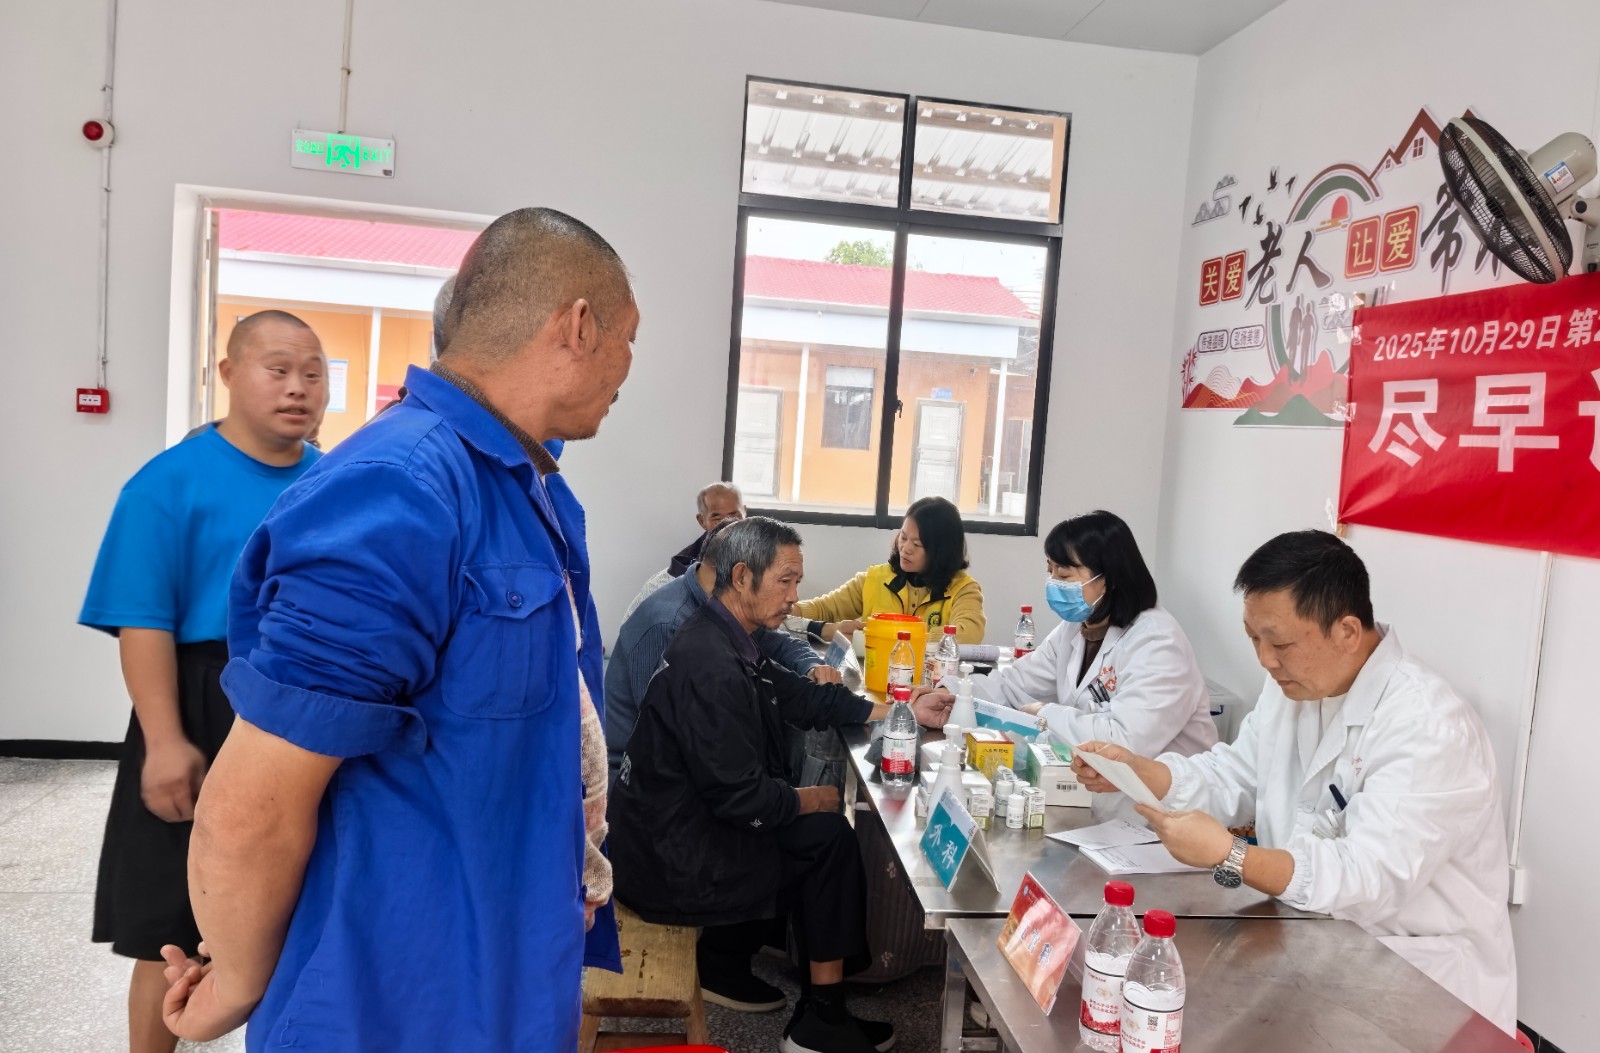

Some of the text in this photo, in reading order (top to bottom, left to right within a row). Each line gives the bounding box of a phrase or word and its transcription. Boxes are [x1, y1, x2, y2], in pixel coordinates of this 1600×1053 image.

[362, 148, 391, 162] EXIT
[1202, 221, 1331, 309] 关爱老人
